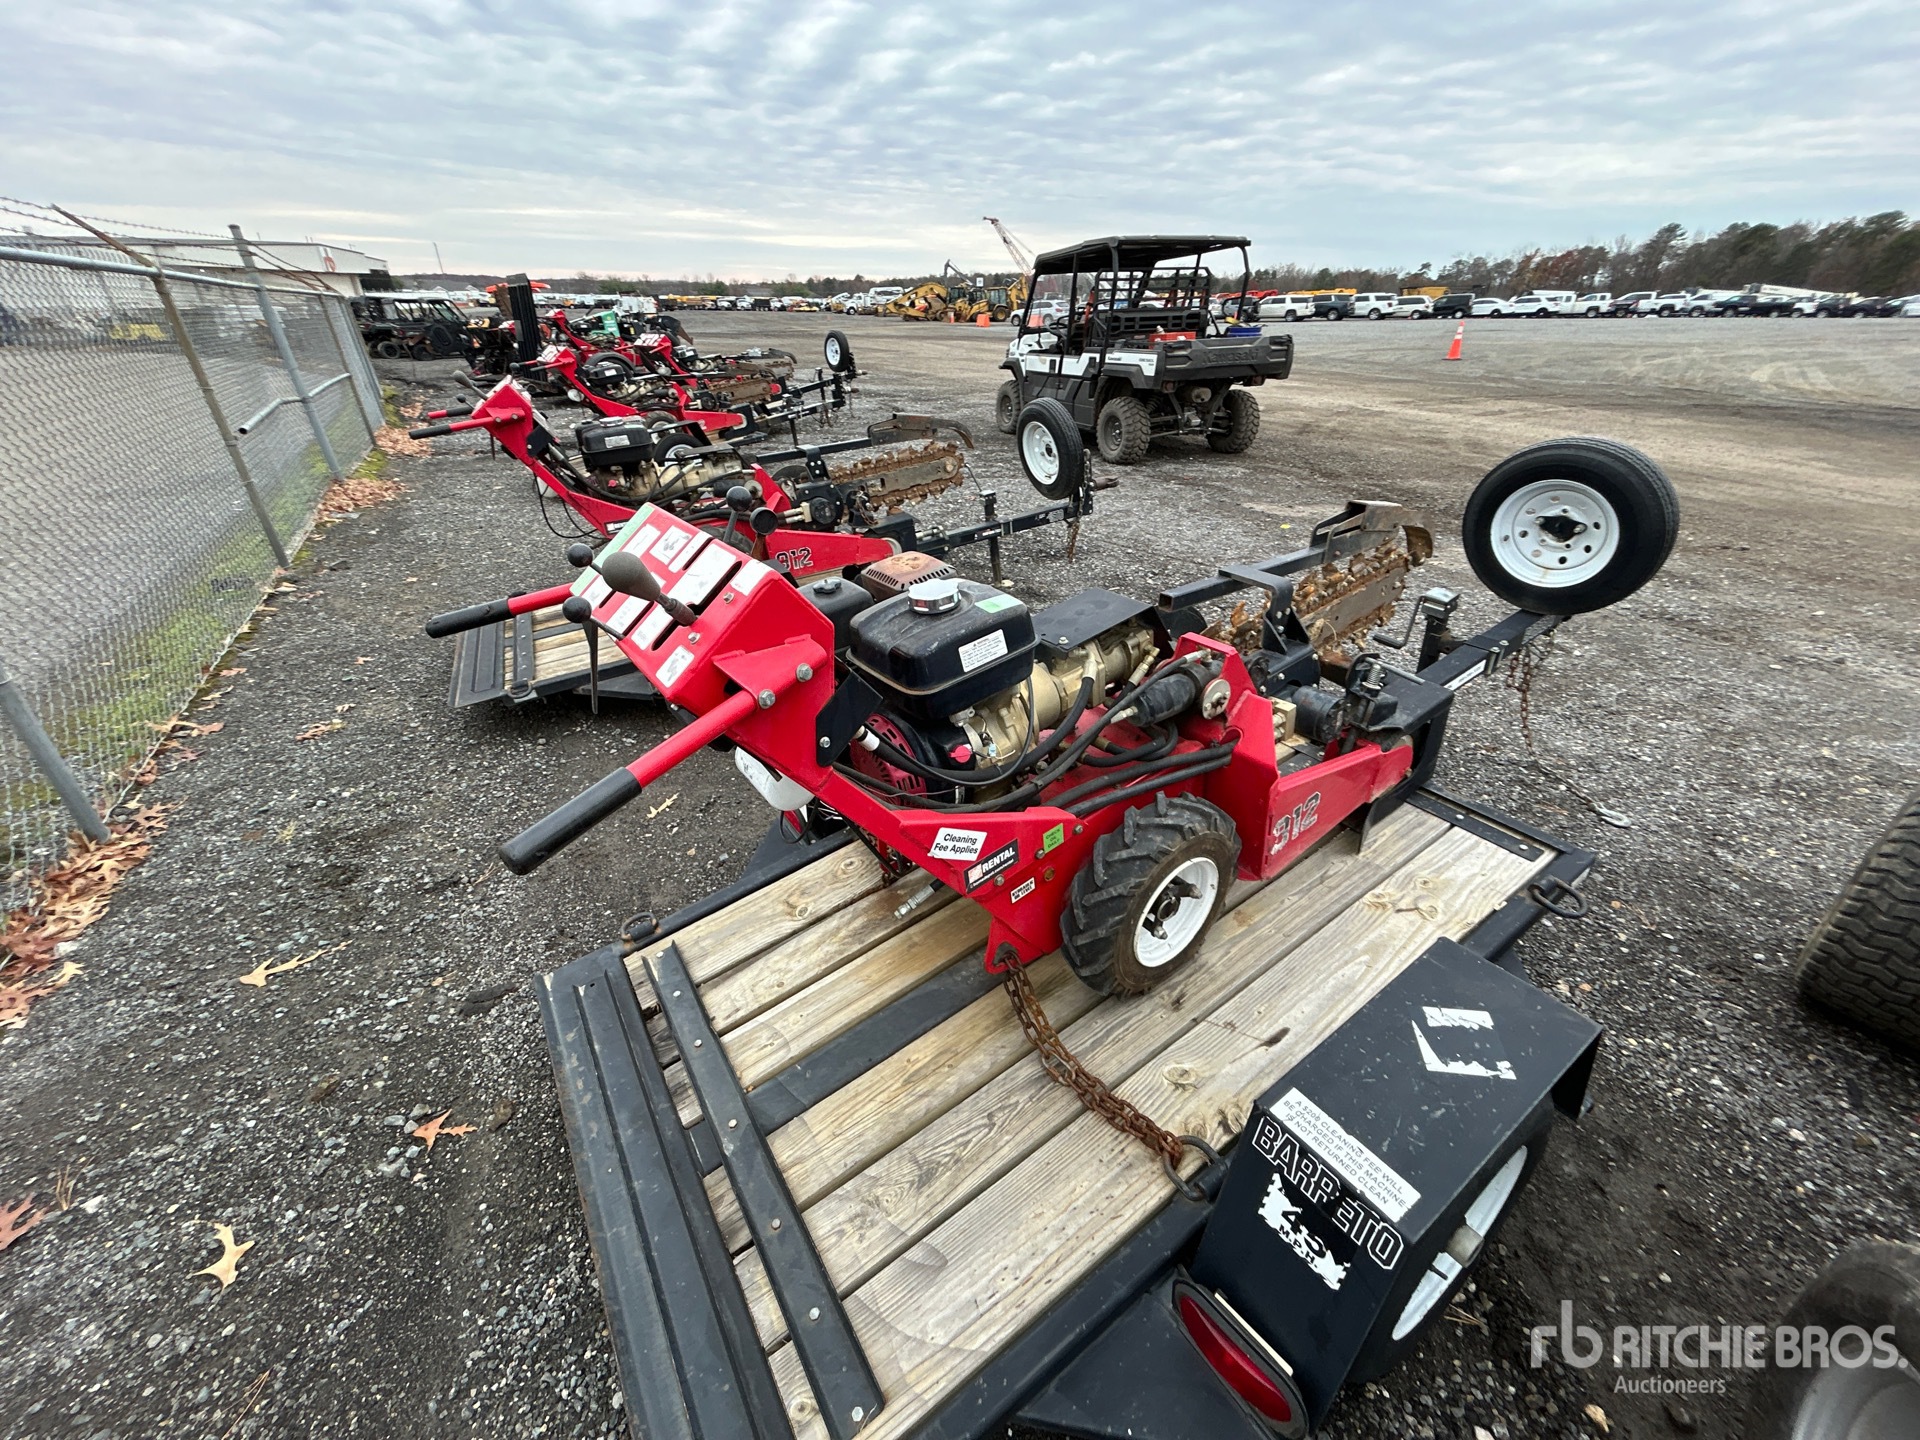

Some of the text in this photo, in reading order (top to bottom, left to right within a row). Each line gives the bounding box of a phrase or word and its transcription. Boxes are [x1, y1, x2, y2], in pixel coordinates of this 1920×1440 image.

[933, 842, 979, 854] Fee Applies
[943, 833, 978, 846] Cleaning
[1270, 791, 1321, 855] 912
[982, 847, 1016, 873] RENTAL
[1284, 1100, 1406, 1208] BE CHARGED IF THIS MACHINE
[1286, 1113, 1389, 1205] IS NOT RETURNED CLEAN
[1302, 1106, 1321, 1122] $200
[1320, 1121, 1364, 1158] CLEANING
[1363, 1156, 1382, 1174] FEE
[1382, 1172, 1403, 1194] WILL
[1279, 1224, 1318, 1268] M.P.H.
